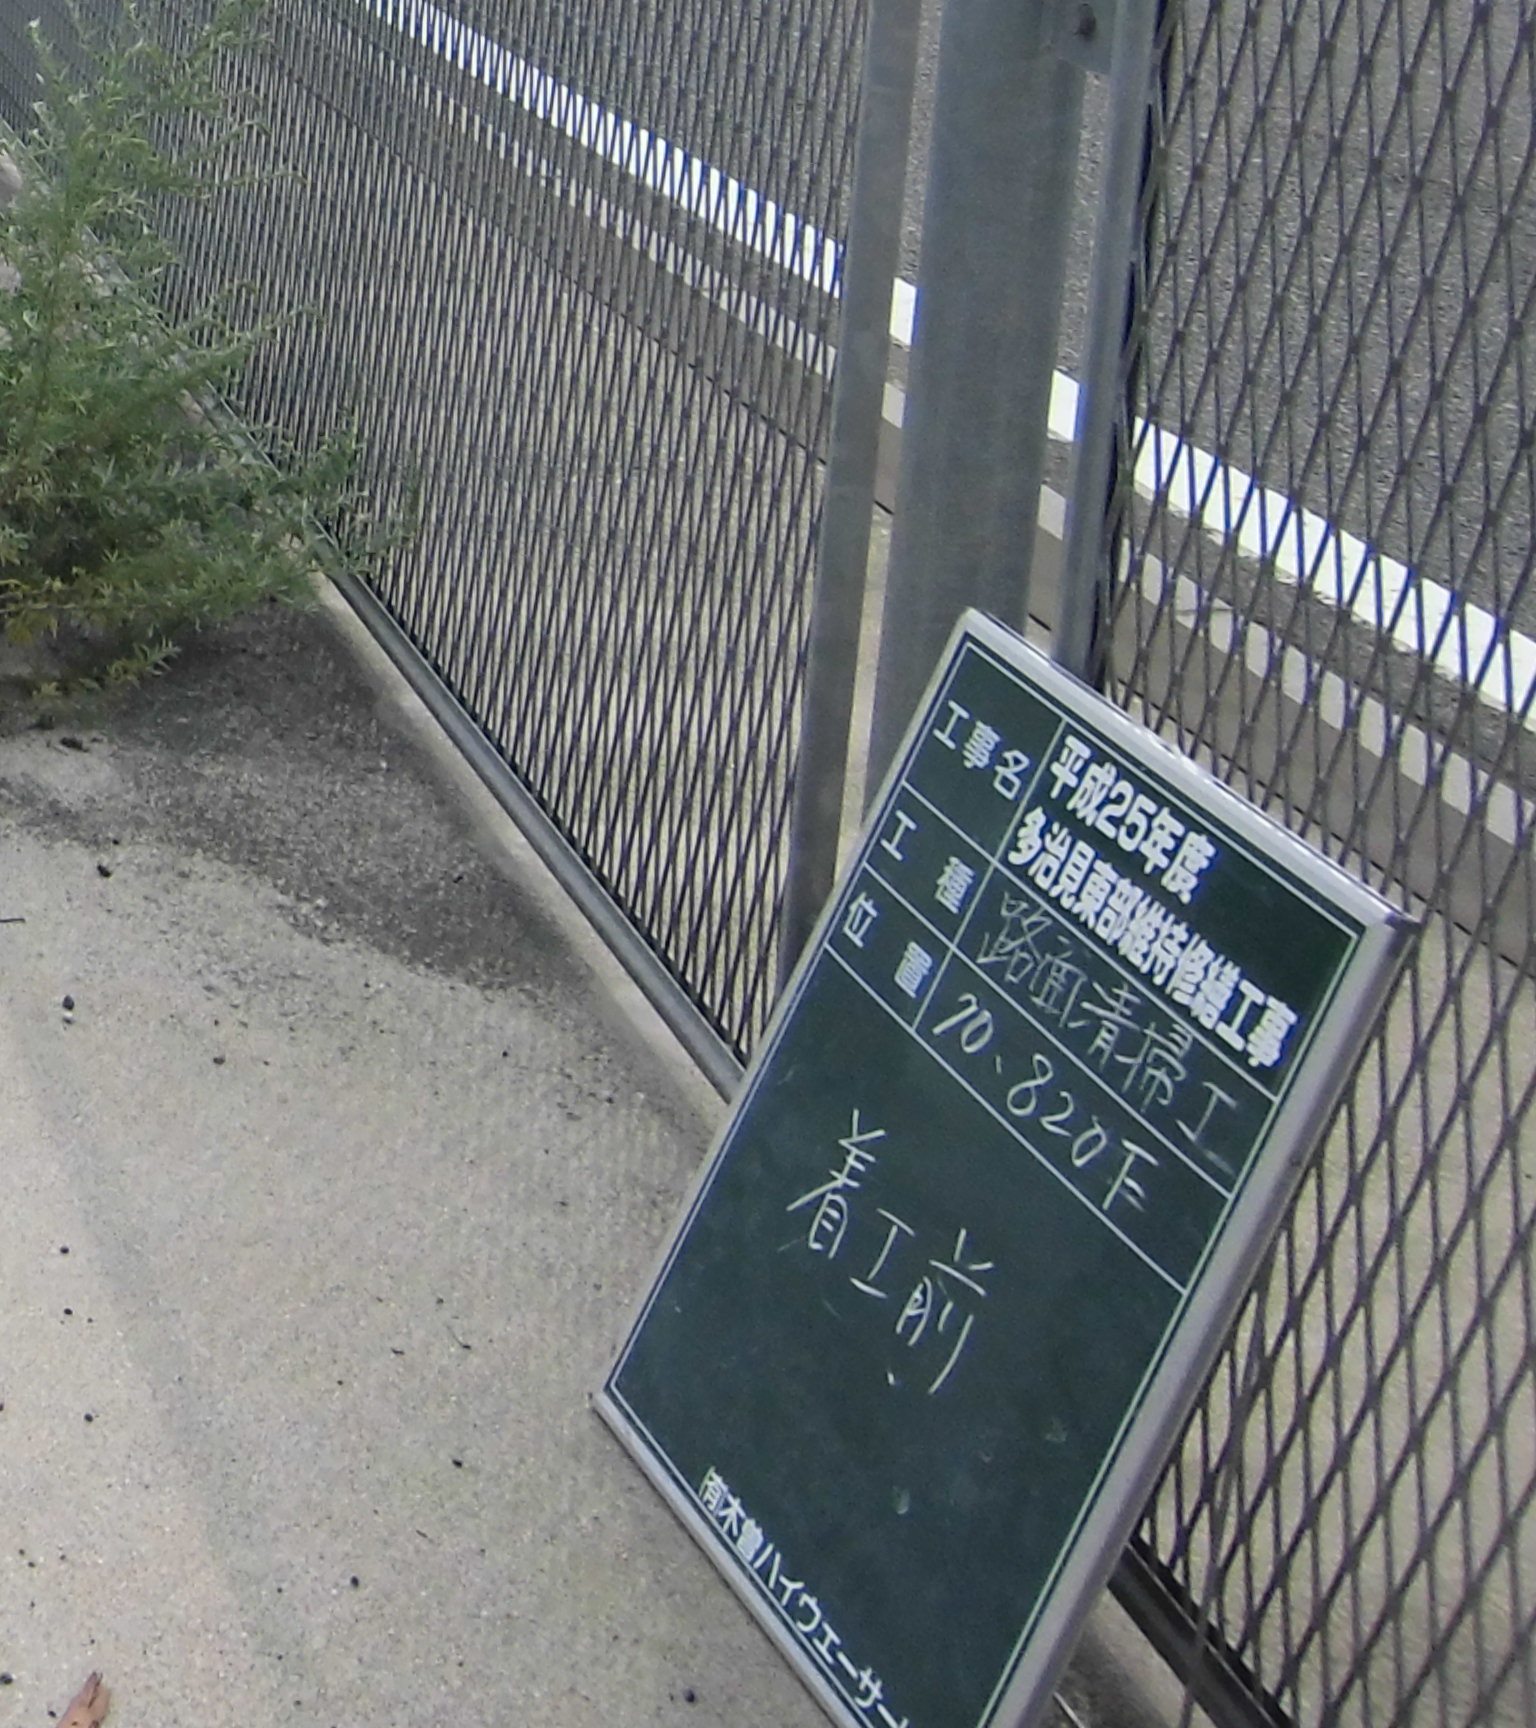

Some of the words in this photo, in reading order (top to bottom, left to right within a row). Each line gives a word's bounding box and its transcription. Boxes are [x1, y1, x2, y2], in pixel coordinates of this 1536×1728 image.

[933, 700, 1030, 802] 工事名
[1049, 734, 1218, 906] 平成25年度
[843, 891, 934, 1000] 位置
[785, 1107, 995, 1395] 着工前
